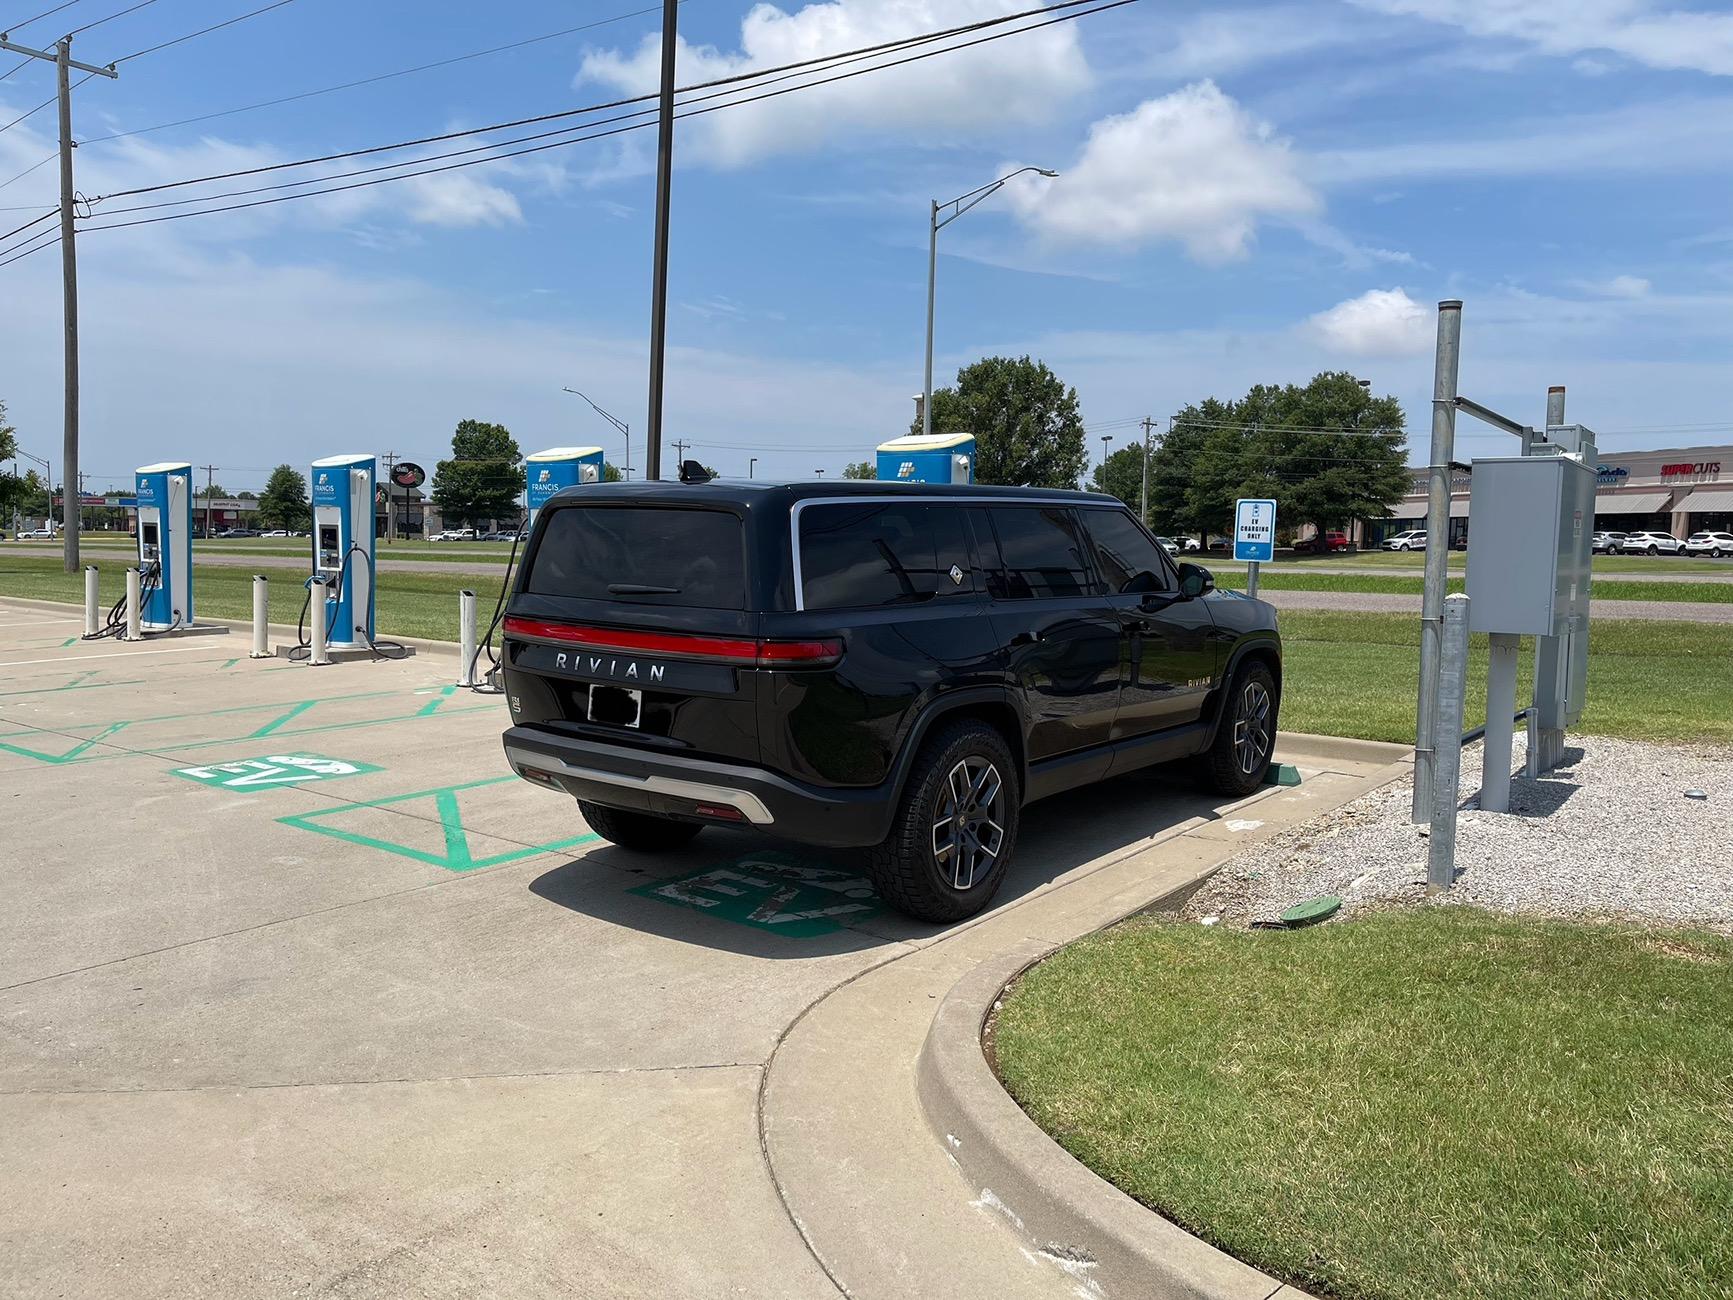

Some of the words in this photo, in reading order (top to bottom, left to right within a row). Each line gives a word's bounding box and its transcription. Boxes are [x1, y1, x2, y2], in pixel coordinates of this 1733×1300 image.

[1660, 462, 1721, 476] SUPERCUTS
[531, 483, 559, 492] FRANCIS
[1240, 525, 1270, 533] CHARGING
[555, 653, 665, 682] RIVIAN
